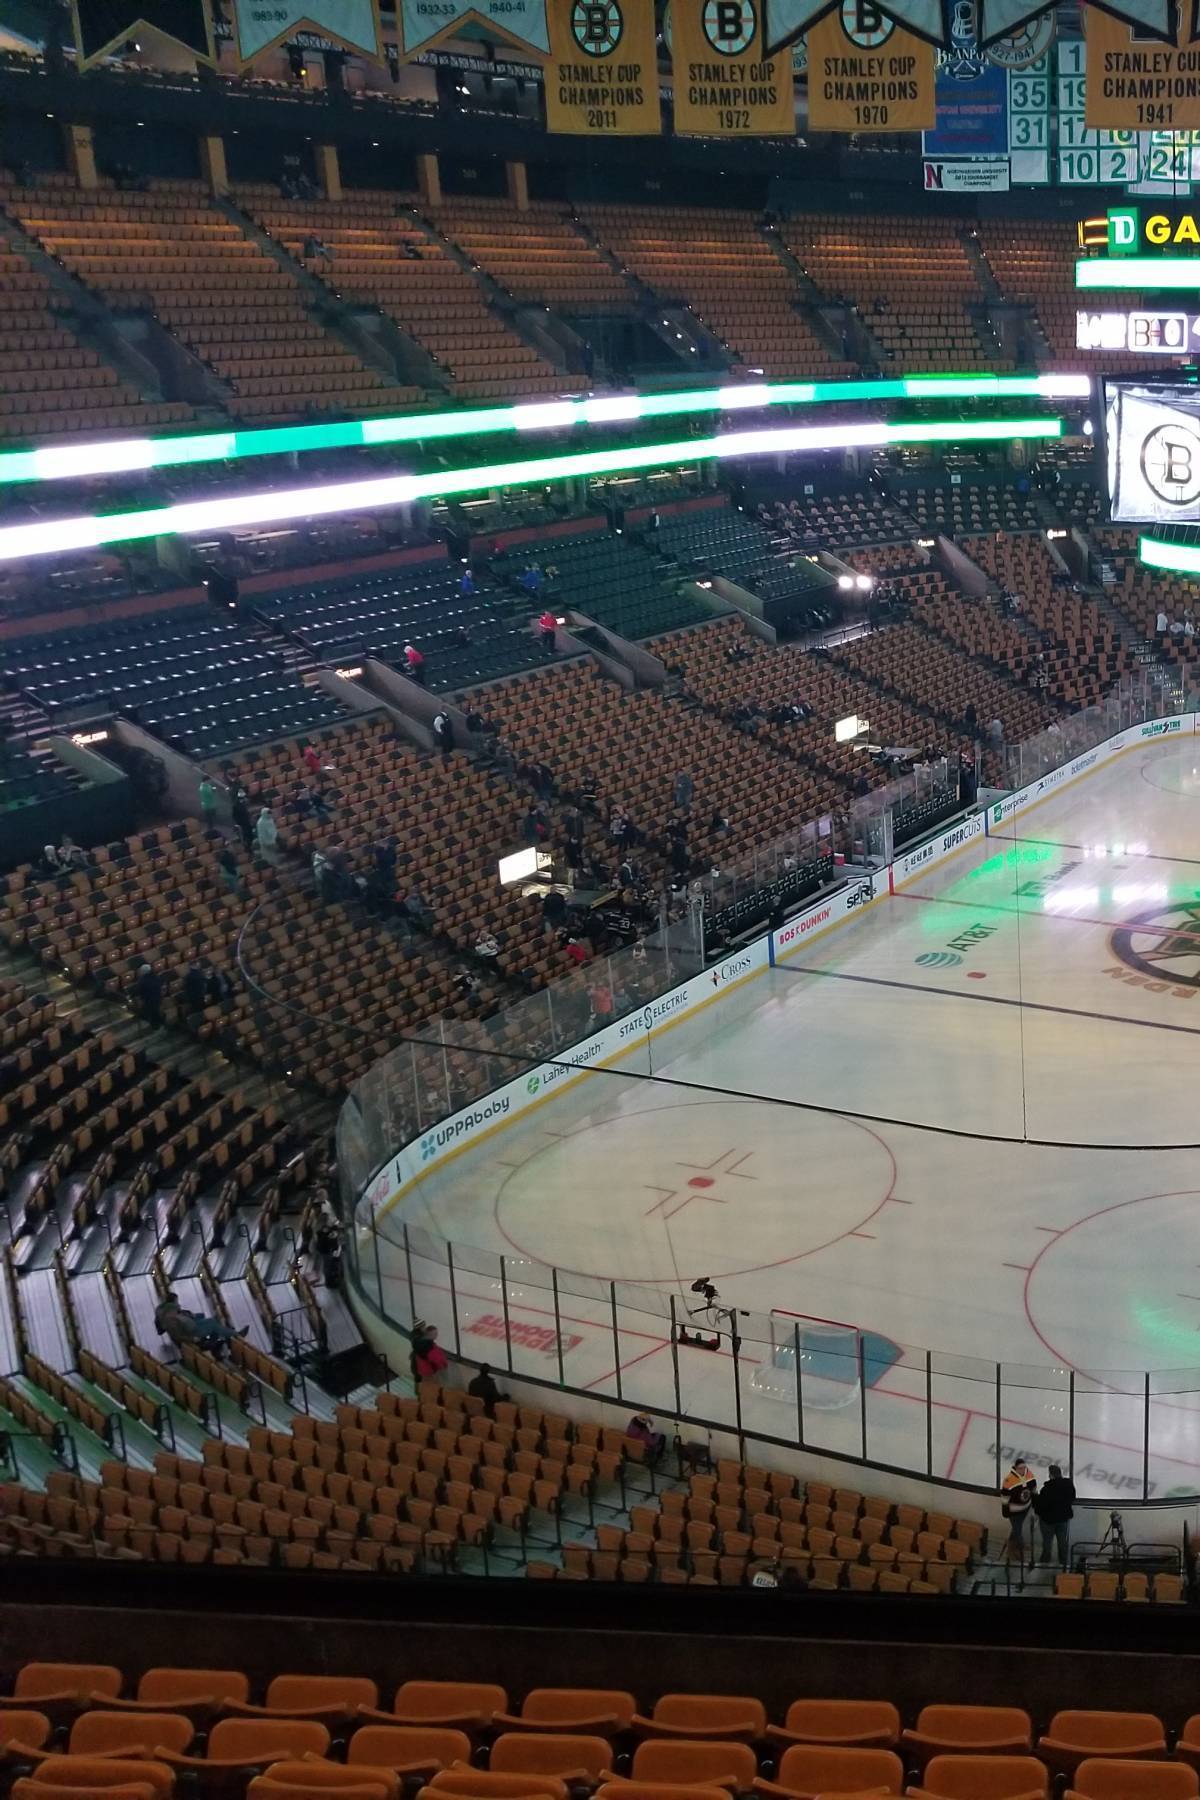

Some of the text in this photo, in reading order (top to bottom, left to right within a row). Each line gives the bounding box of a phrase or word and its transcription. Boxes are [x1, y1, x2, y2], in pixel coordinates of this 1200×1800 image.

[689, 63, 775, 83] STANLEY CUP
[824, 57, 885, 77] STANLEY
[889, 57, 916, 75] CUP
[1104, 53, 1172, 73] STANLEY
[559, 64, 641, 83] STANLEY CUP
[559, 87, 643, 105] CHAMPIONS
[689, 86, 777, 106] CHAMPIONS
[824, 81, 918, 101] CHAMPIONS
[1013, 81, 1046, 108] 35
[588, 110, 617, 128] 2011
[718, 110, 750, 129] 1972
[854, 106, 888, 125] 1970
[1136, 103, 1174, 123] 1941
[1015, 117, 1044, 144] 31
[1062, 152, 1093, 180] 10
[1110, 152, 1127, 179] 2
[1152, 150, 1187, 176] 24
[1110, 215, 1136, 244] TD
[943, 818, 981, 852] SUPERCUTS
[779, 930, 796, 945] BOS
[947, 922, 998, 952] AT&T
[619, 1017, 643, 1038] STATE
[653, 990, 688, 1019] ELECTRIC
